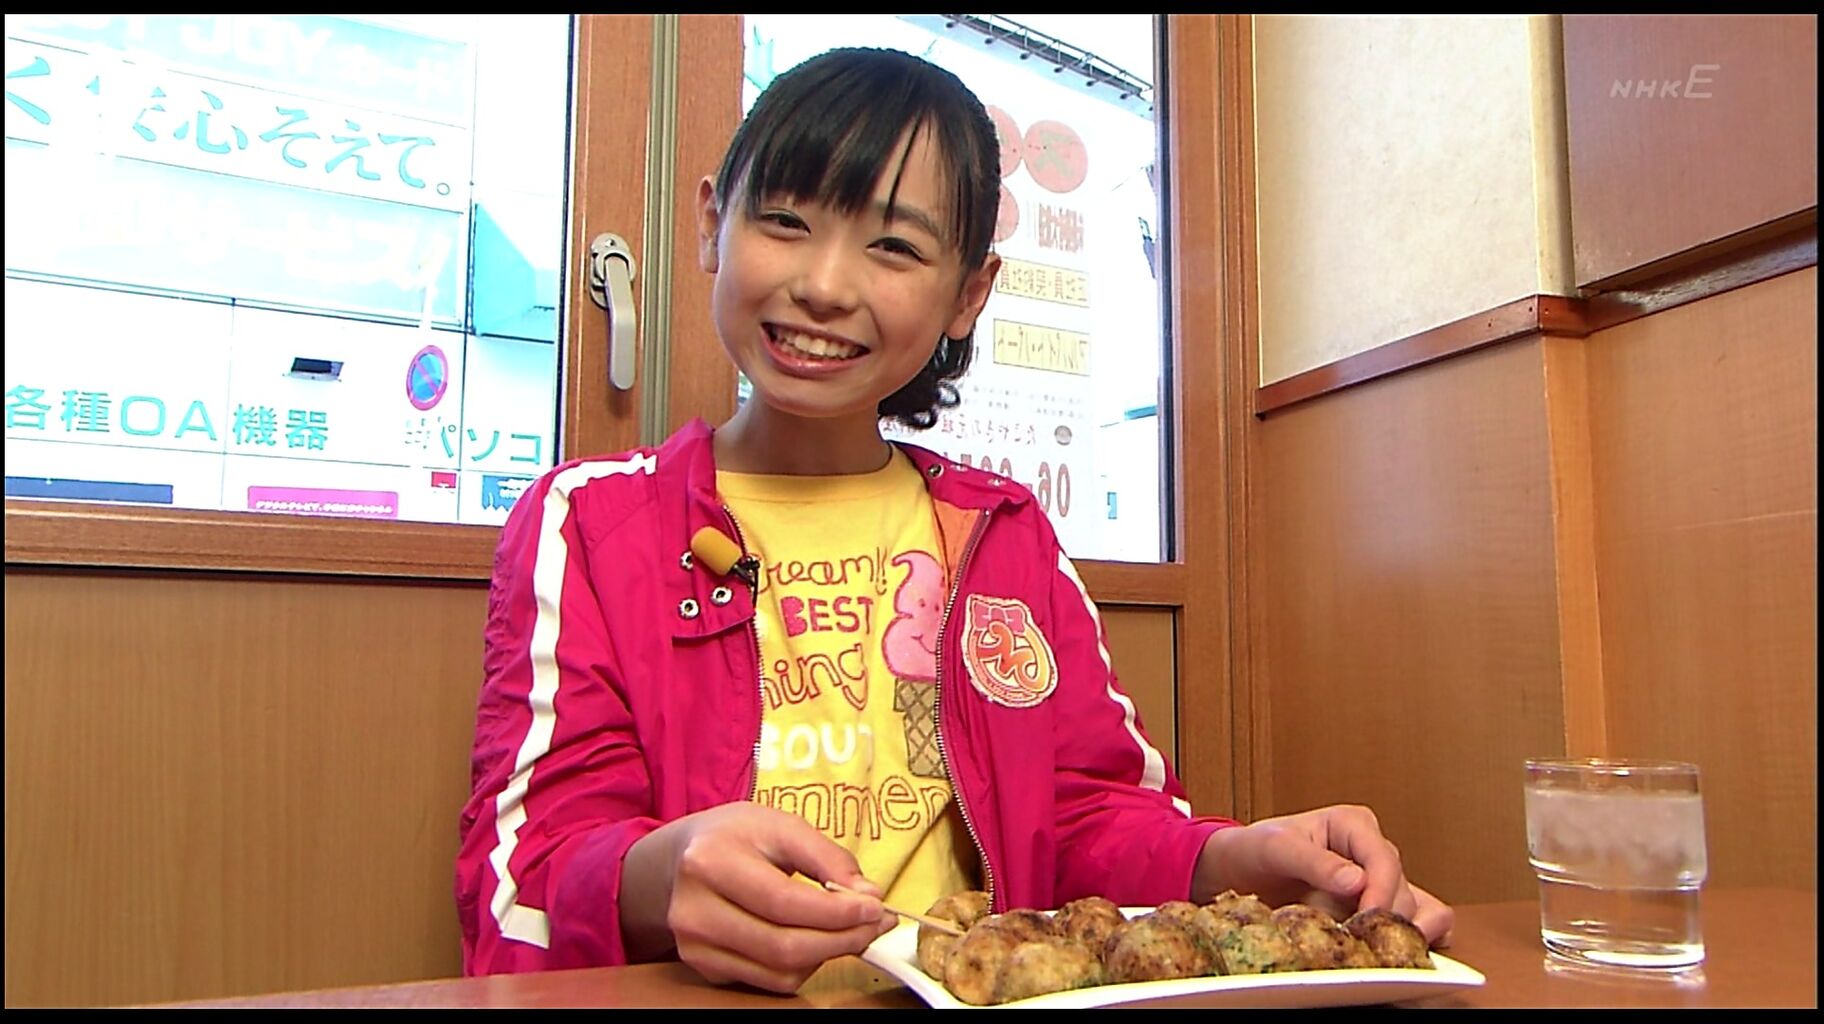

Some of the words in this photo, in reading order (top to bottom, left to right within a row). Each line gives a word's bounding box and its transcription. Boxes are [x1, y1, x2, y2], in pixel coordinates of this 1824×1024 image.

[5, 384, 329, 451] 各種OA機器
[780, 596, 875, 638] BEST
[757, 775, 951, 840] mmer
